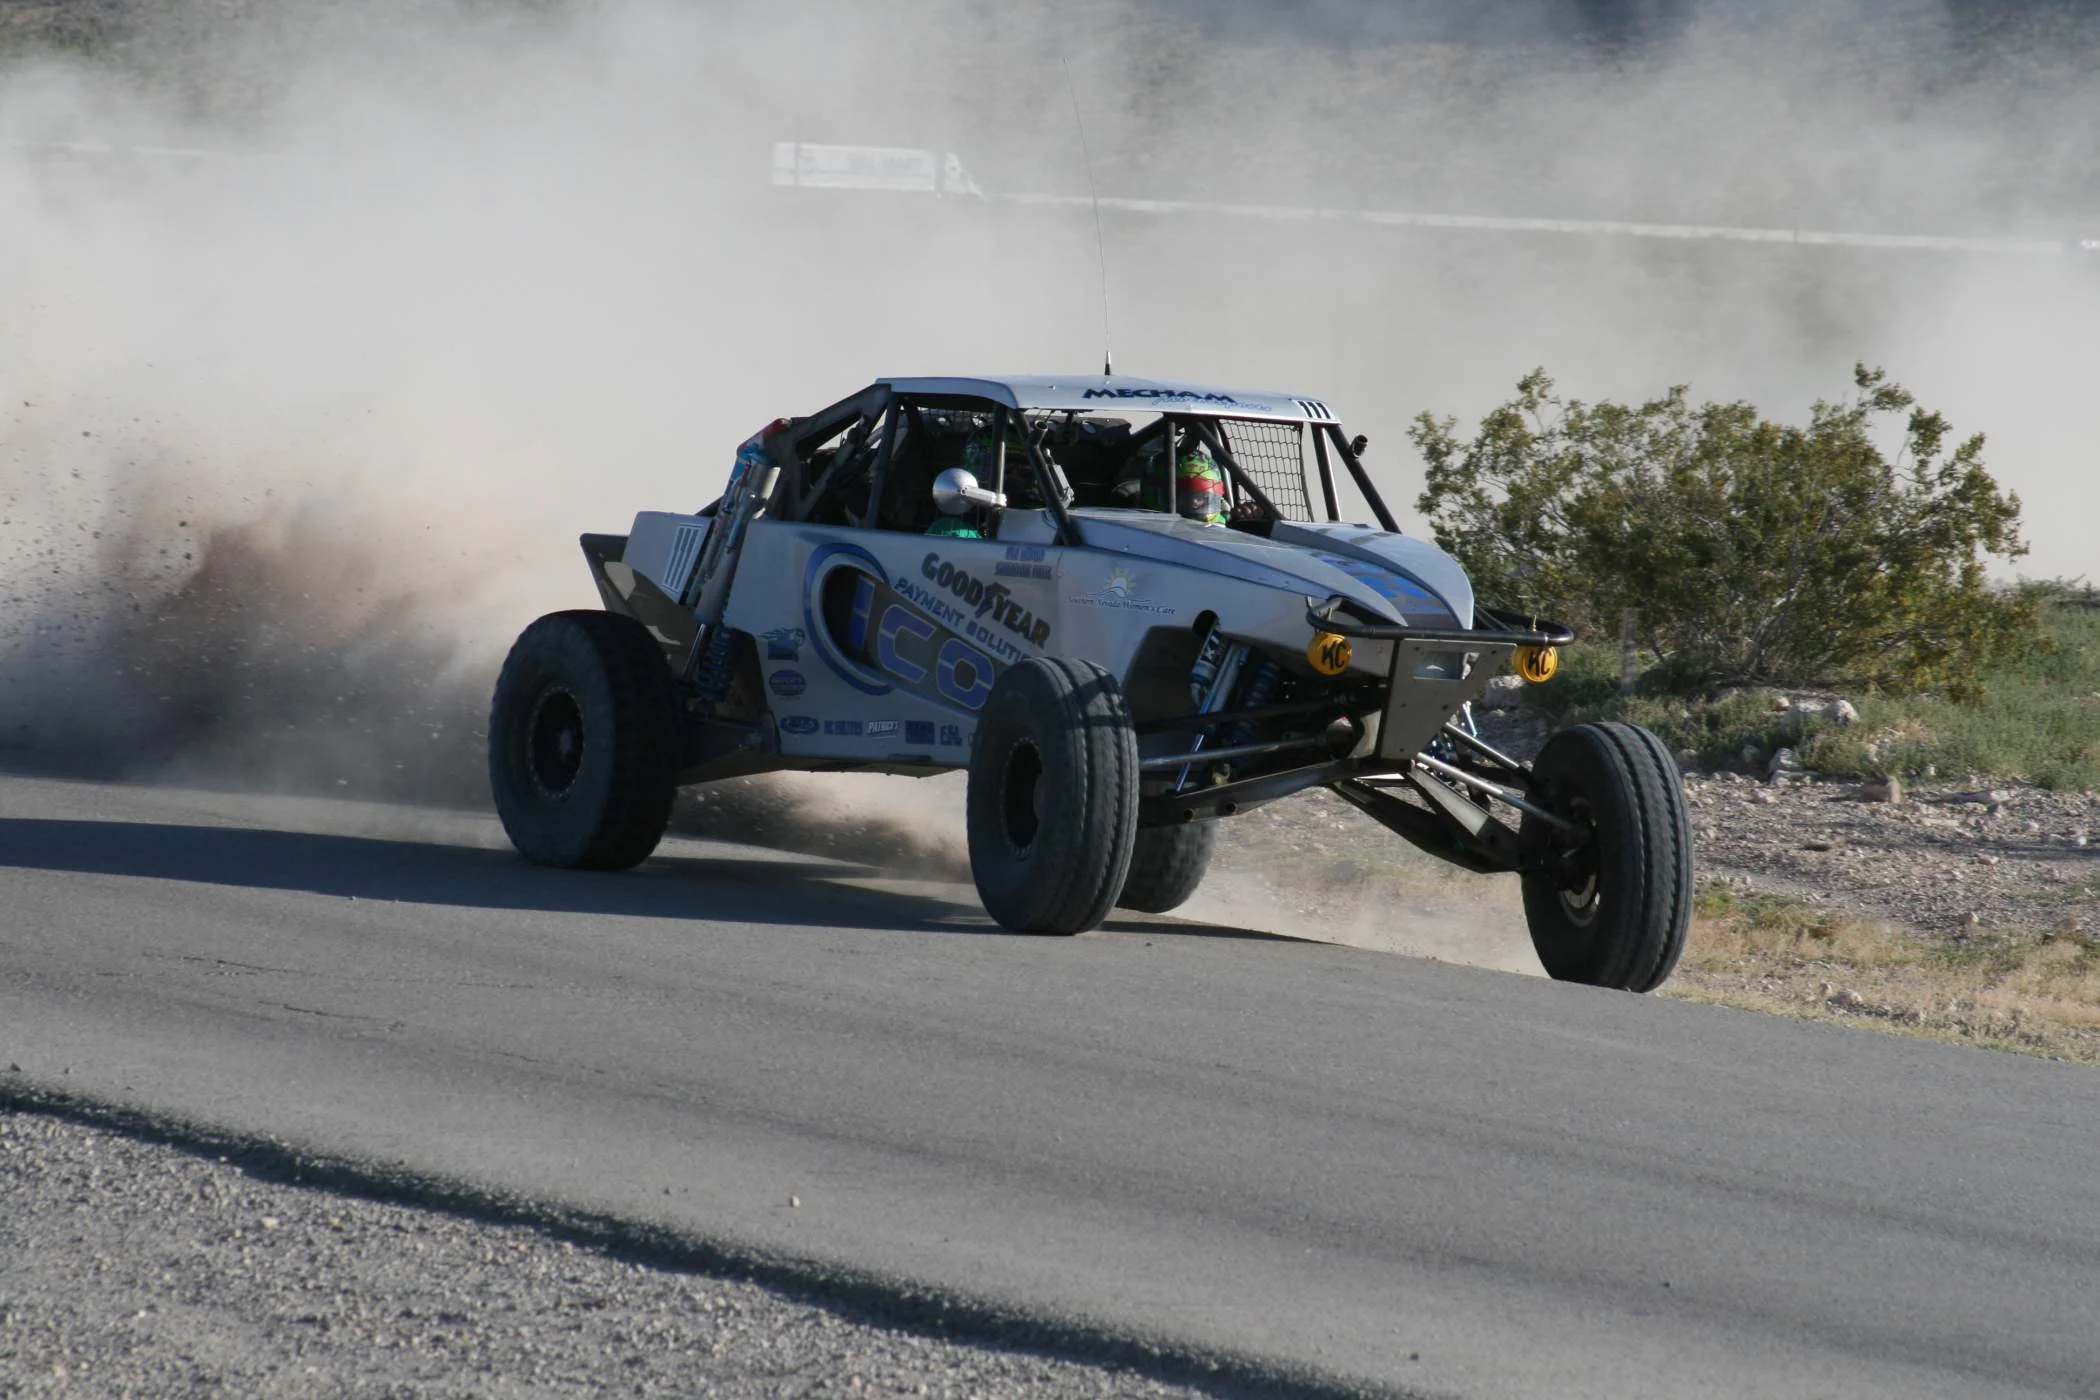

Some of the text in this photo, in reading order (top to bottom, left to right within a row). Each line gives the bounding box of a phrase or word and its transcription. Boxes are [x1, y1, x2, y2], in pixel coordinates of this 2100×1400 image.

[1081, 388, 1238, 405] MECHAM
[894, 576, 965, 627] PAYMENT
[920, 551, 1051, 650] GOODYEAR
[1156, 604, 1177, 616] Care
[1321, 640, 1347, 671] KC
[1527, 649, 1552, 677] KC
